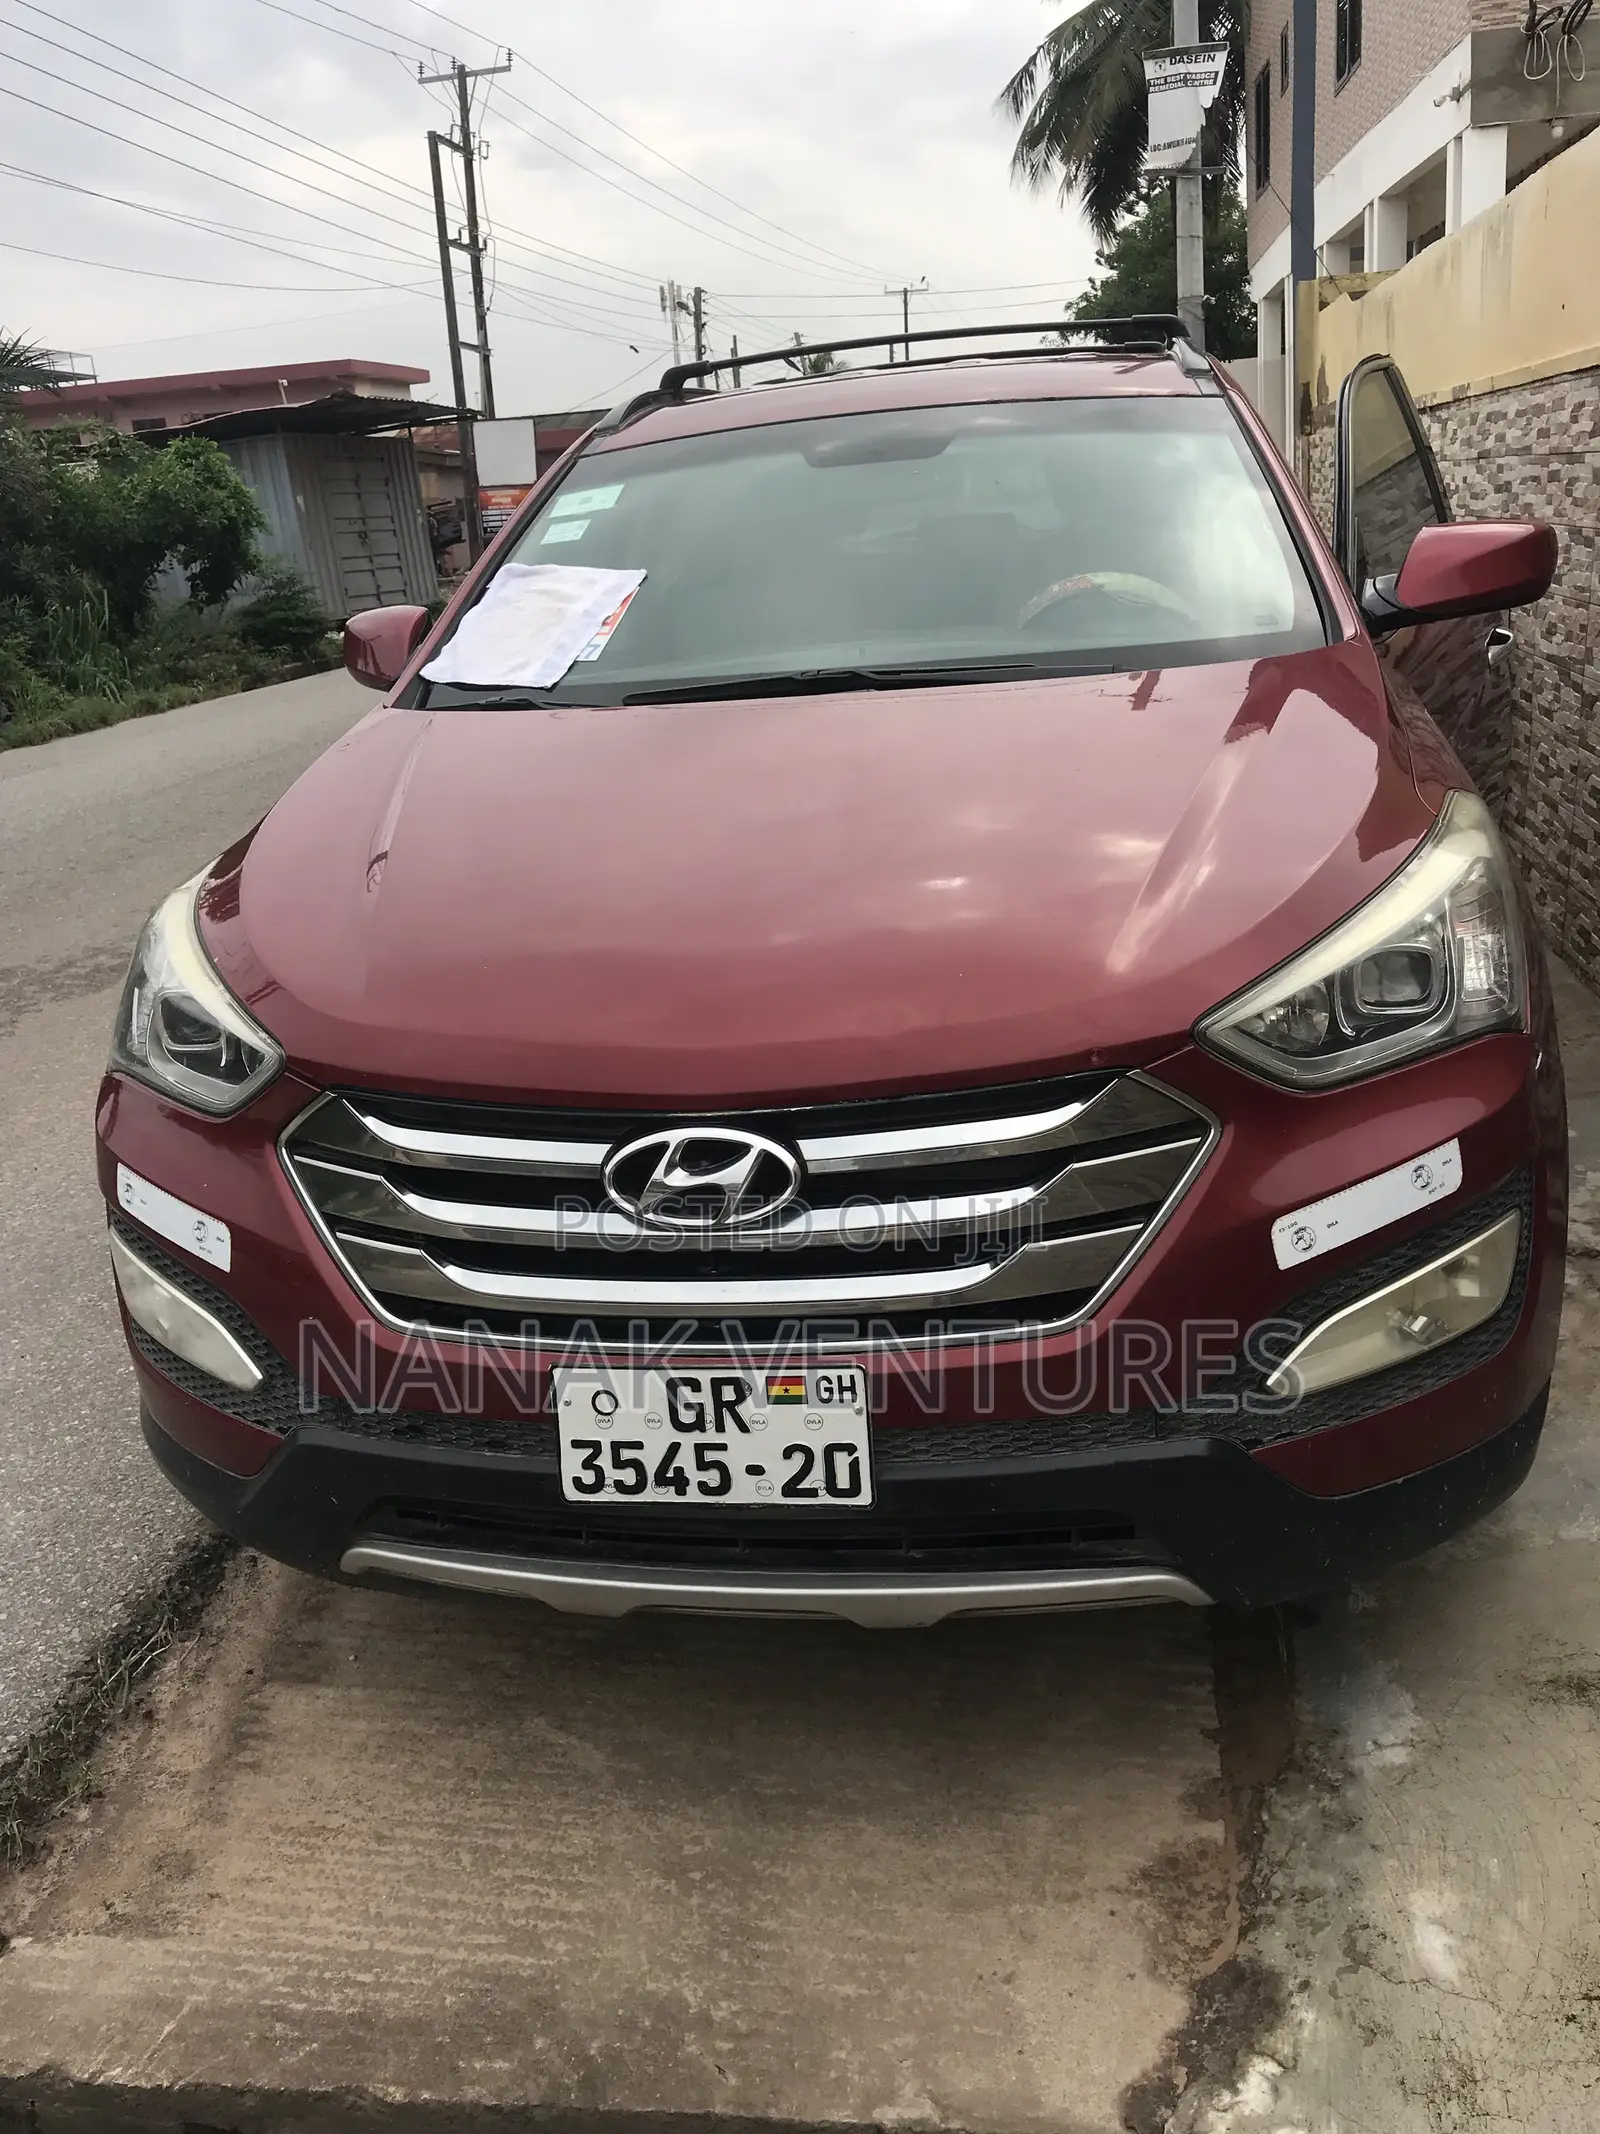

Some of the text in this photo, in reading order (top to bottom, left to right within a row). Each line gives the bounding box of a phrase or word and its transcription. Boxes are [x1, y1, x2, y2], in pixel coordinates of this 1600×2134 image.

[1170, 54, 1216, 65] DASEIN
[1149, 77, 1166, 86] THE
[1166, 73, 1185, 83] BEST
[1149, 80, 1185, 93] REMEDIAL
[665, 1374, 857, 1433] GR GH
